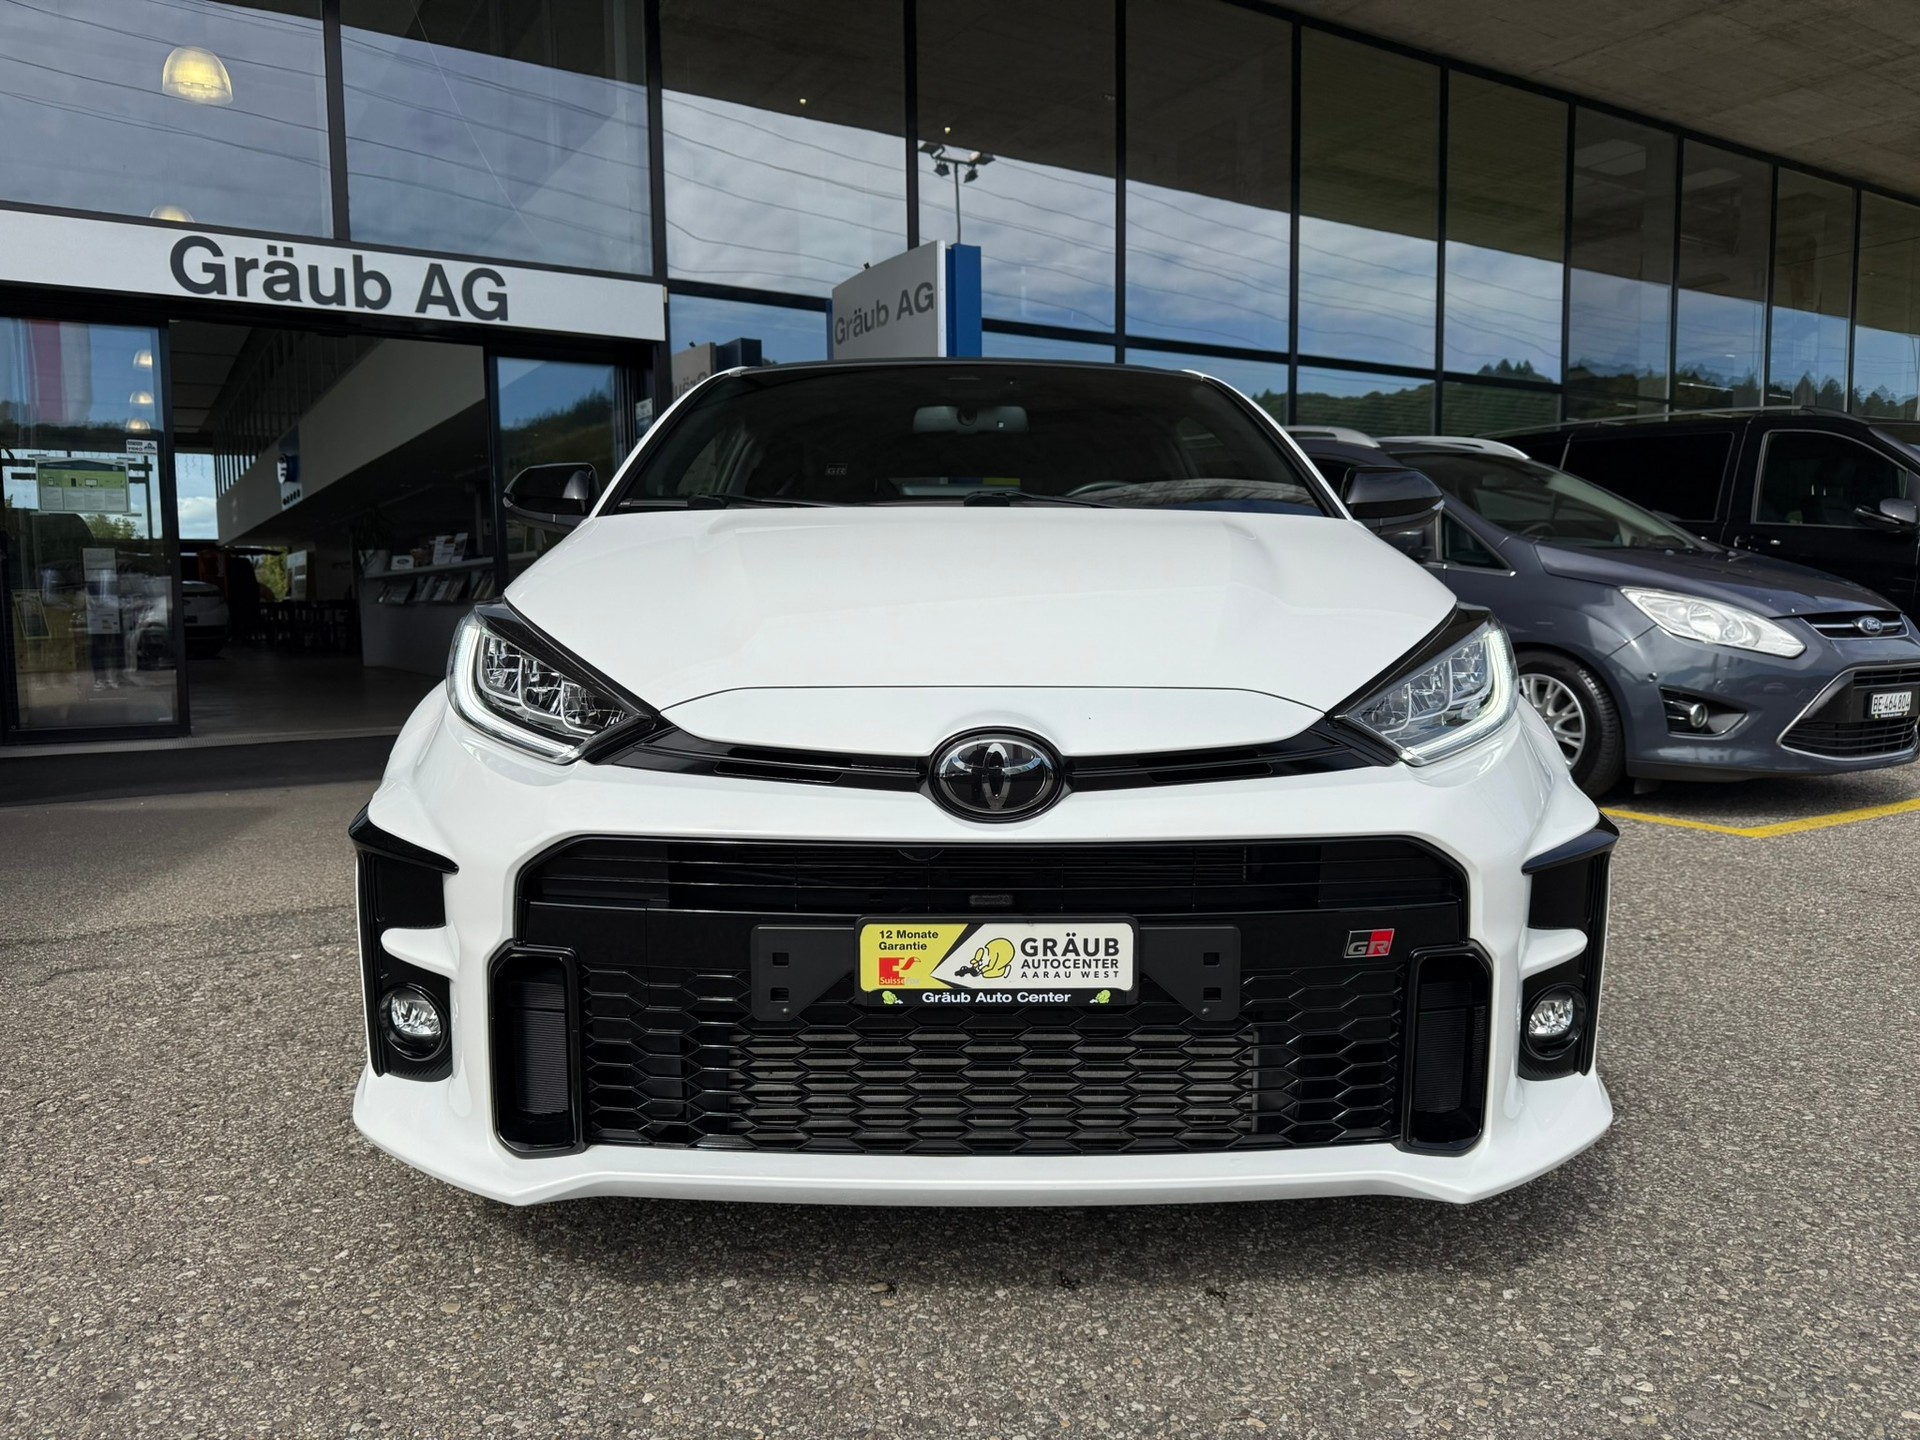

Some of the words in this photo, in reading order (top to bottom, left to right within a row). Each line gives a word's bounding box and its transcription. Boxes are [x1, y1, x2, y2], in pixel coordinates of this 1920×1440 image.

[170, 235, 392, 310] Gräub
[415, 263, 508, 321] AG
[834, 299, 889, 345] Gräub
[896, 282, 934, 321] AG
[879, 930, 893, 939] 12
[896, 930, 939, 939] Monate
[879, 941, 927, 951] Garantie
[1020, 932, 1119, 957] GRÄUB
[1021, 959, 1119, 969] AUTOCENTER
[1021, 970, 1072, 978] AARAU
[1081, 970, 1119, 978] WEST
[922, 991, 971, 1003] Gräub
[975, 991, 1013, 1003] Auto
[1017, 991, 1071, 1003] Center
